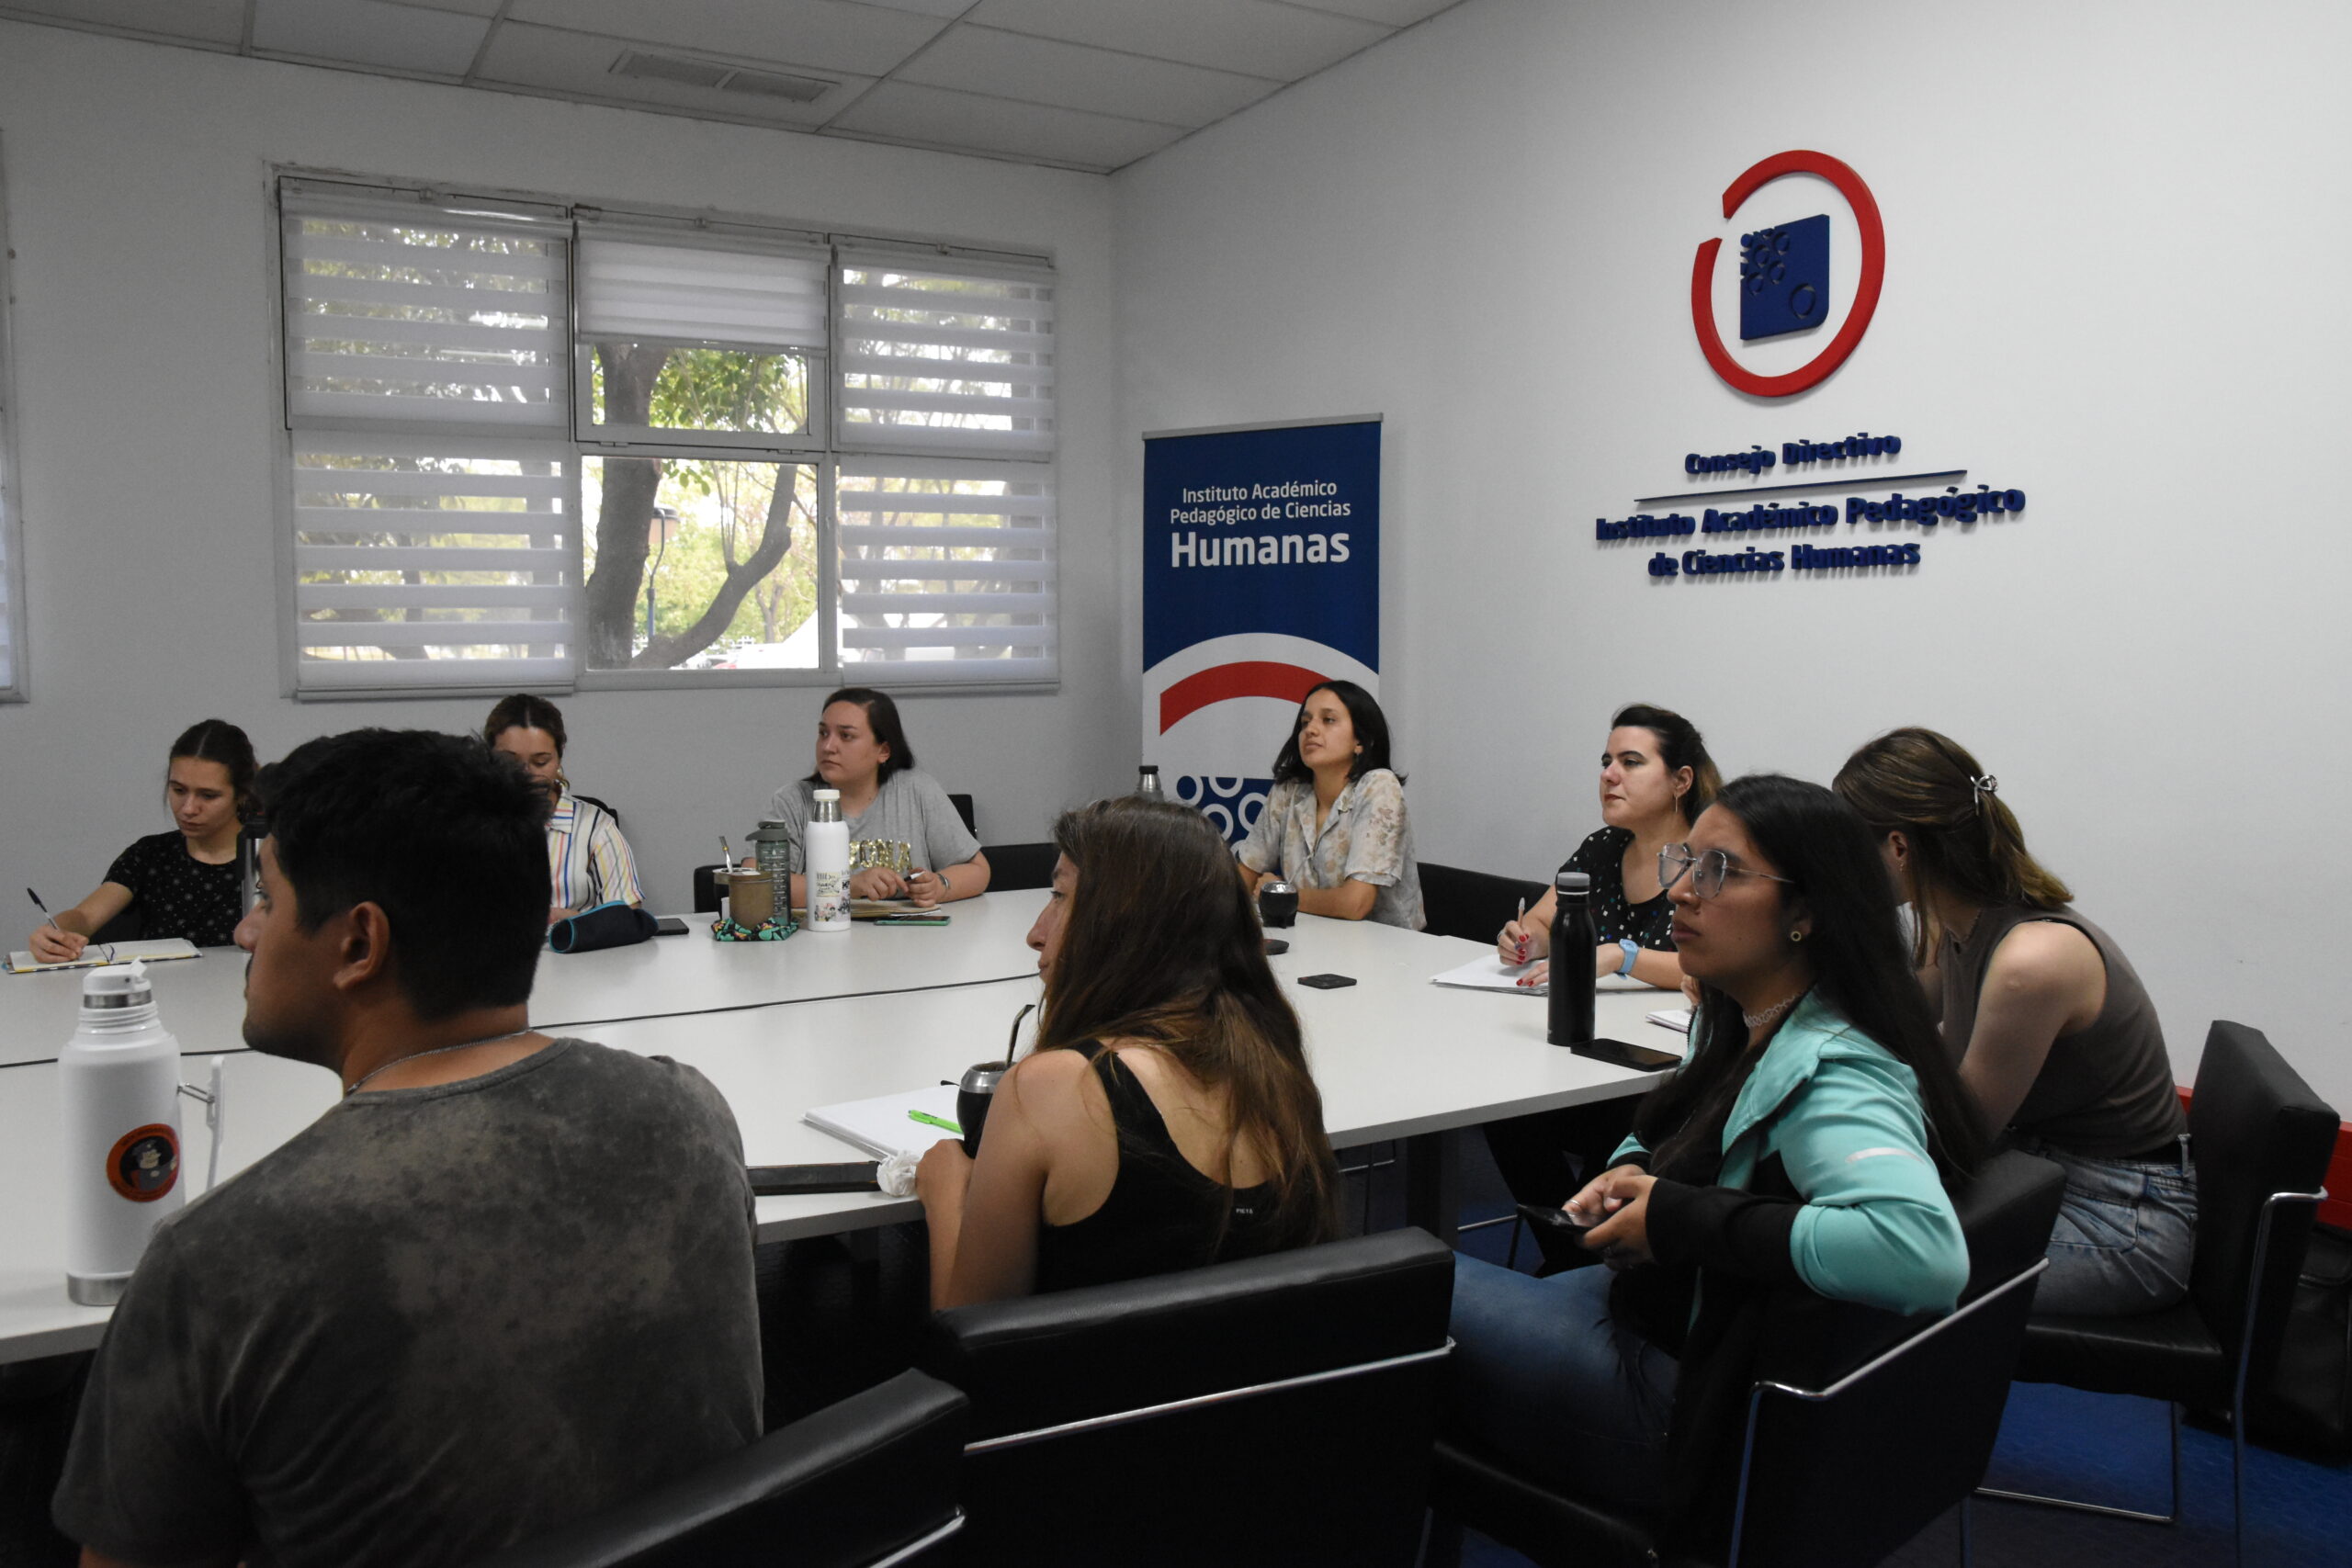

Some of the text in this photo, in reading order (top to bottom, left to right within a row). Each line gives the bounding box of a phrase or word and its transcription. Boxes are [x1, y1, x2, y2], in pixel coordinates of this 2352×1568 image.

[1684, 432, 1902, 474] Consejo Directivo
[1182, 479, 1337, 503] Instituto Académico
[1170, 500, 1351, 526] Pedagógico de Ciencias
[1595, 483, 2026, 541] Instituto Académico Pedagógico
[1171, 531, 1350, 568] Humanas
[1647, 542, 1921, 577] de Ciencias Humanas
